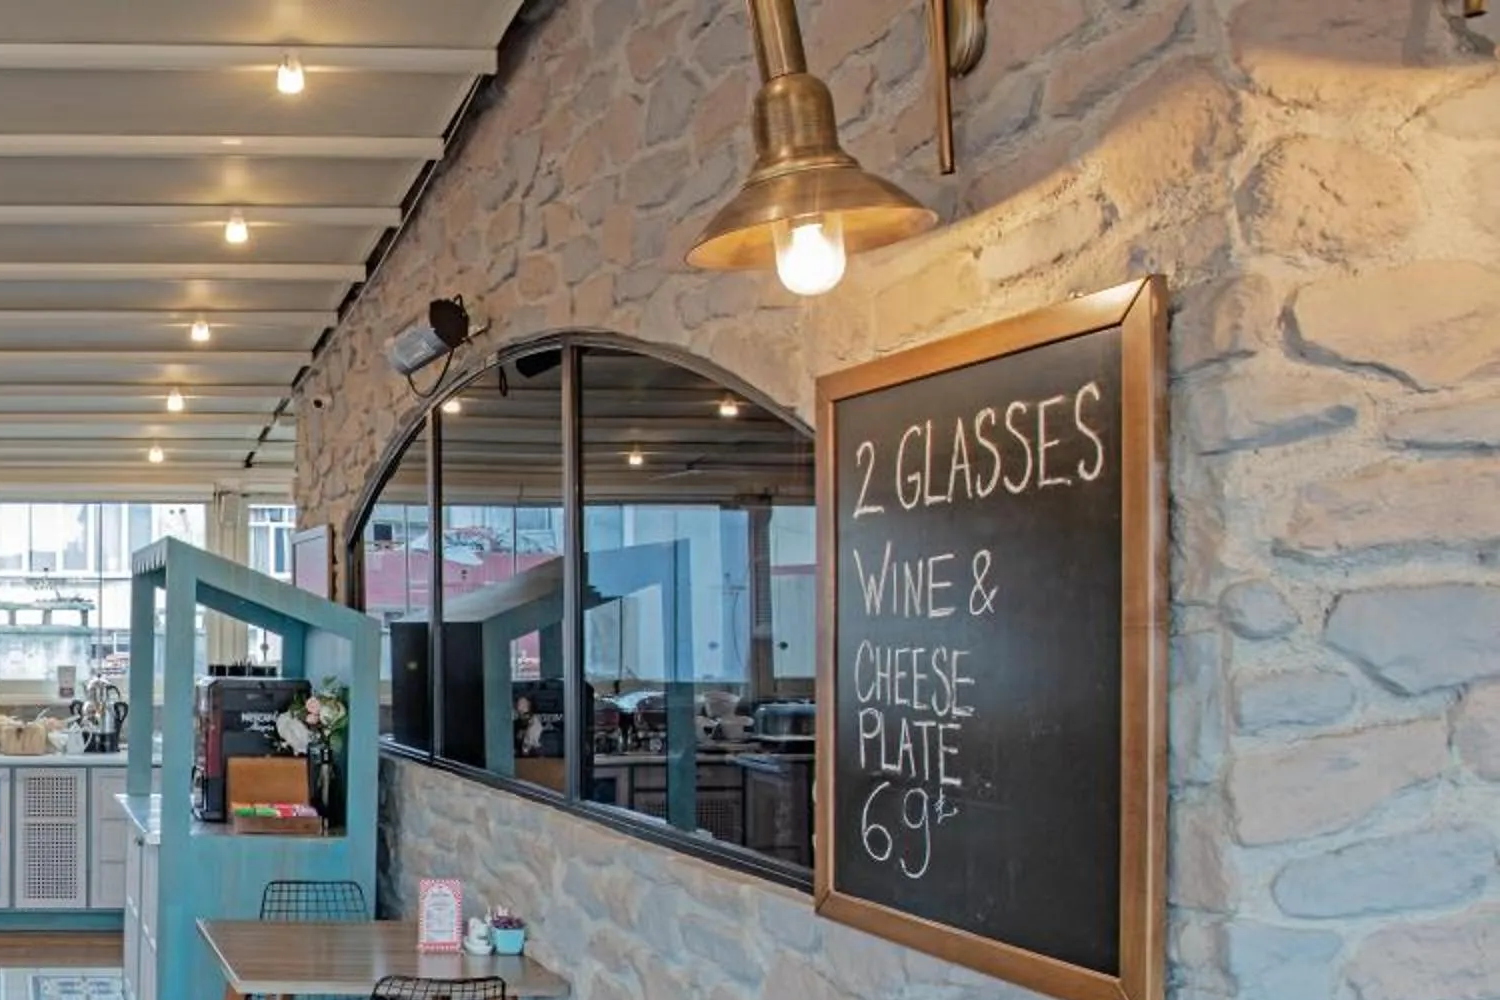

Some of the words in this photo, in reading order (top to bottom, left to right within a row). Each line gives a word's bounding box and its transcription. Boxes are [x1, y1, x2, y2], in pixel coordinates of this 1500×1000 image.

[854, 441, 885, 518] 2
[896, 382, 1103, 511] GLASSES
[853, 541, 956, 618] WINE
[969, 549, 998, 615] &
[854, 640, 975, 717] CHEESE
[858, 707, 962, 785] PLATE
